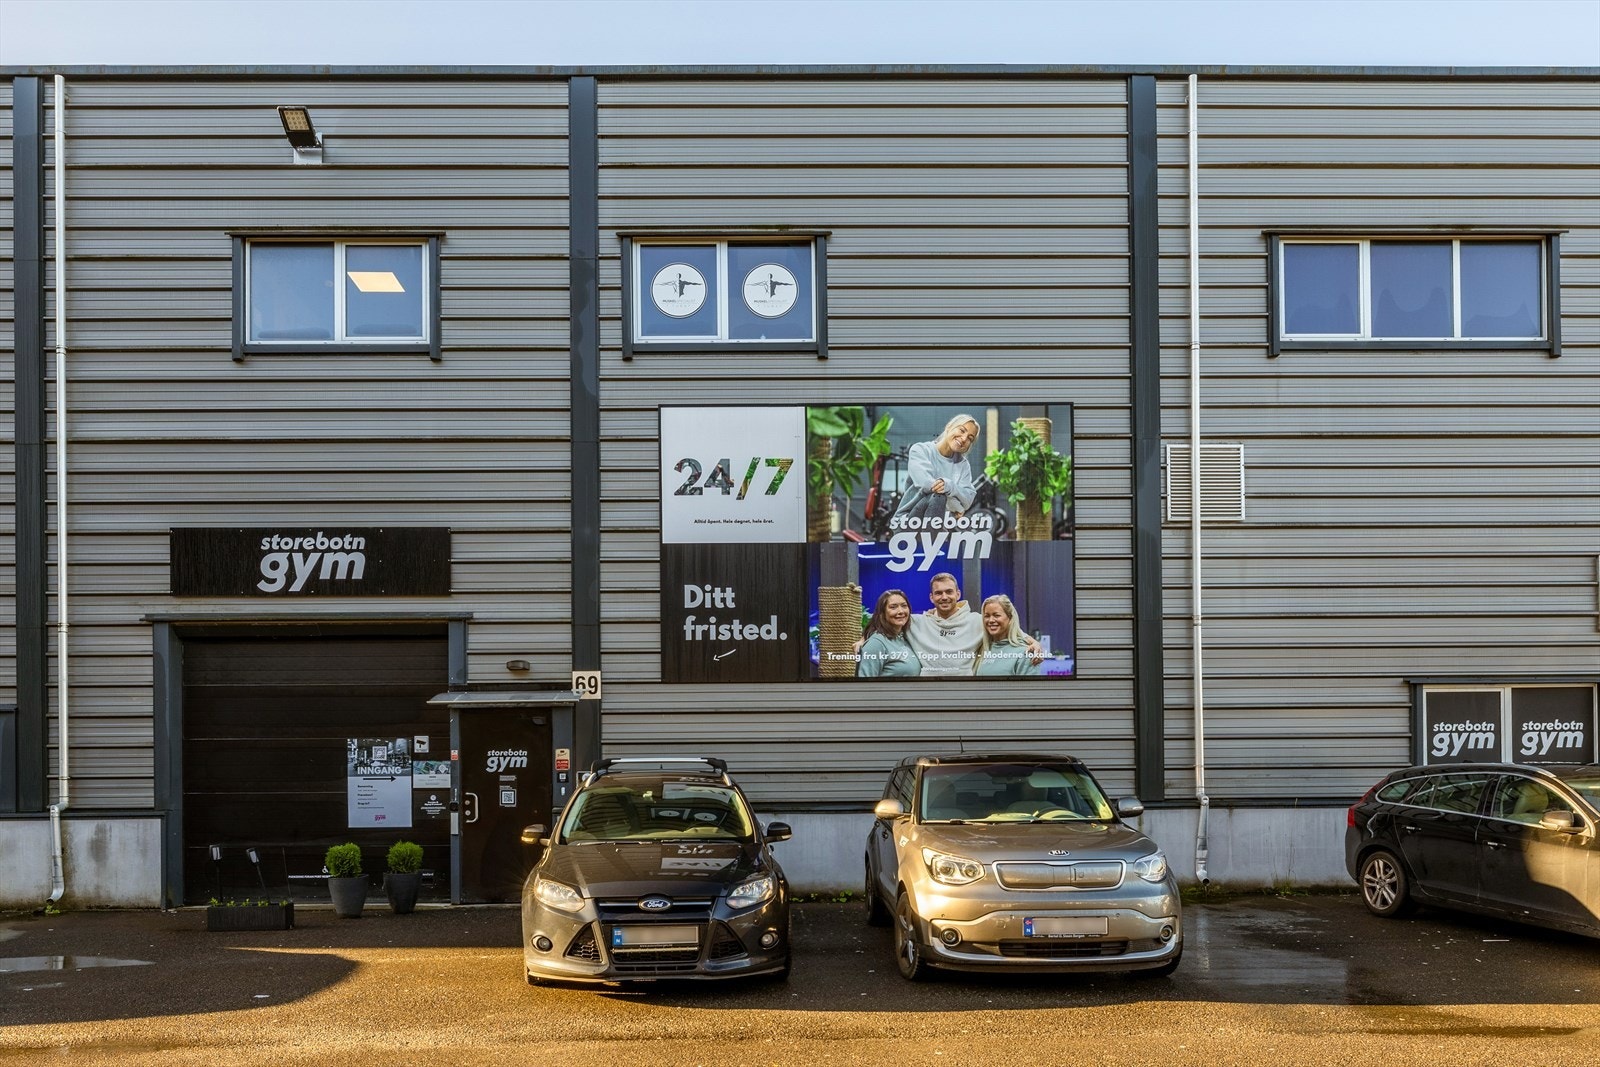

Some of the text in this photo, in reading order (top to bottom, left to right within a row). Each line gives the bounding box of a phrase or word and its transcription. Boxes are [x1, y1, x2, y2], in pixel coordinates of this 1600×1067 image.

[673, 457, 794, 500] 24/7
[889, 511, 993, 529] storebotn
[260, 531, 366, 550] storebotn
[885, 531, 993, 572] gym
[256, 551, 366, 593] gym
[684, 584, 736, 608] Ditt
[683, 615, 788, 641] fristed.
[827, 652, 861, 662] Trening
[863, 652, 877, 660] fra
[879, 652, 889, 660] kr
[890, 651, 908, 660] 379
[917, 651, 939, 660] Topp
[941, 650, 975, 659] kvalitet
[983, 650, 1024, 659] Moderne
[575, 675, 599, 695] 69
[1433, 720, 1495, 732] storebotn
[1522, 719, 1584, 731] storebotn
[487, 748, 528, 757] storebotn
[1431, 731, 1496, 757] gym
[1520, 730, 1584, 756] gym
[357, 766, 402, 775] INNGANG
[485, 756, 528, 773] gym
[647, 900, 664, 908] Ford
